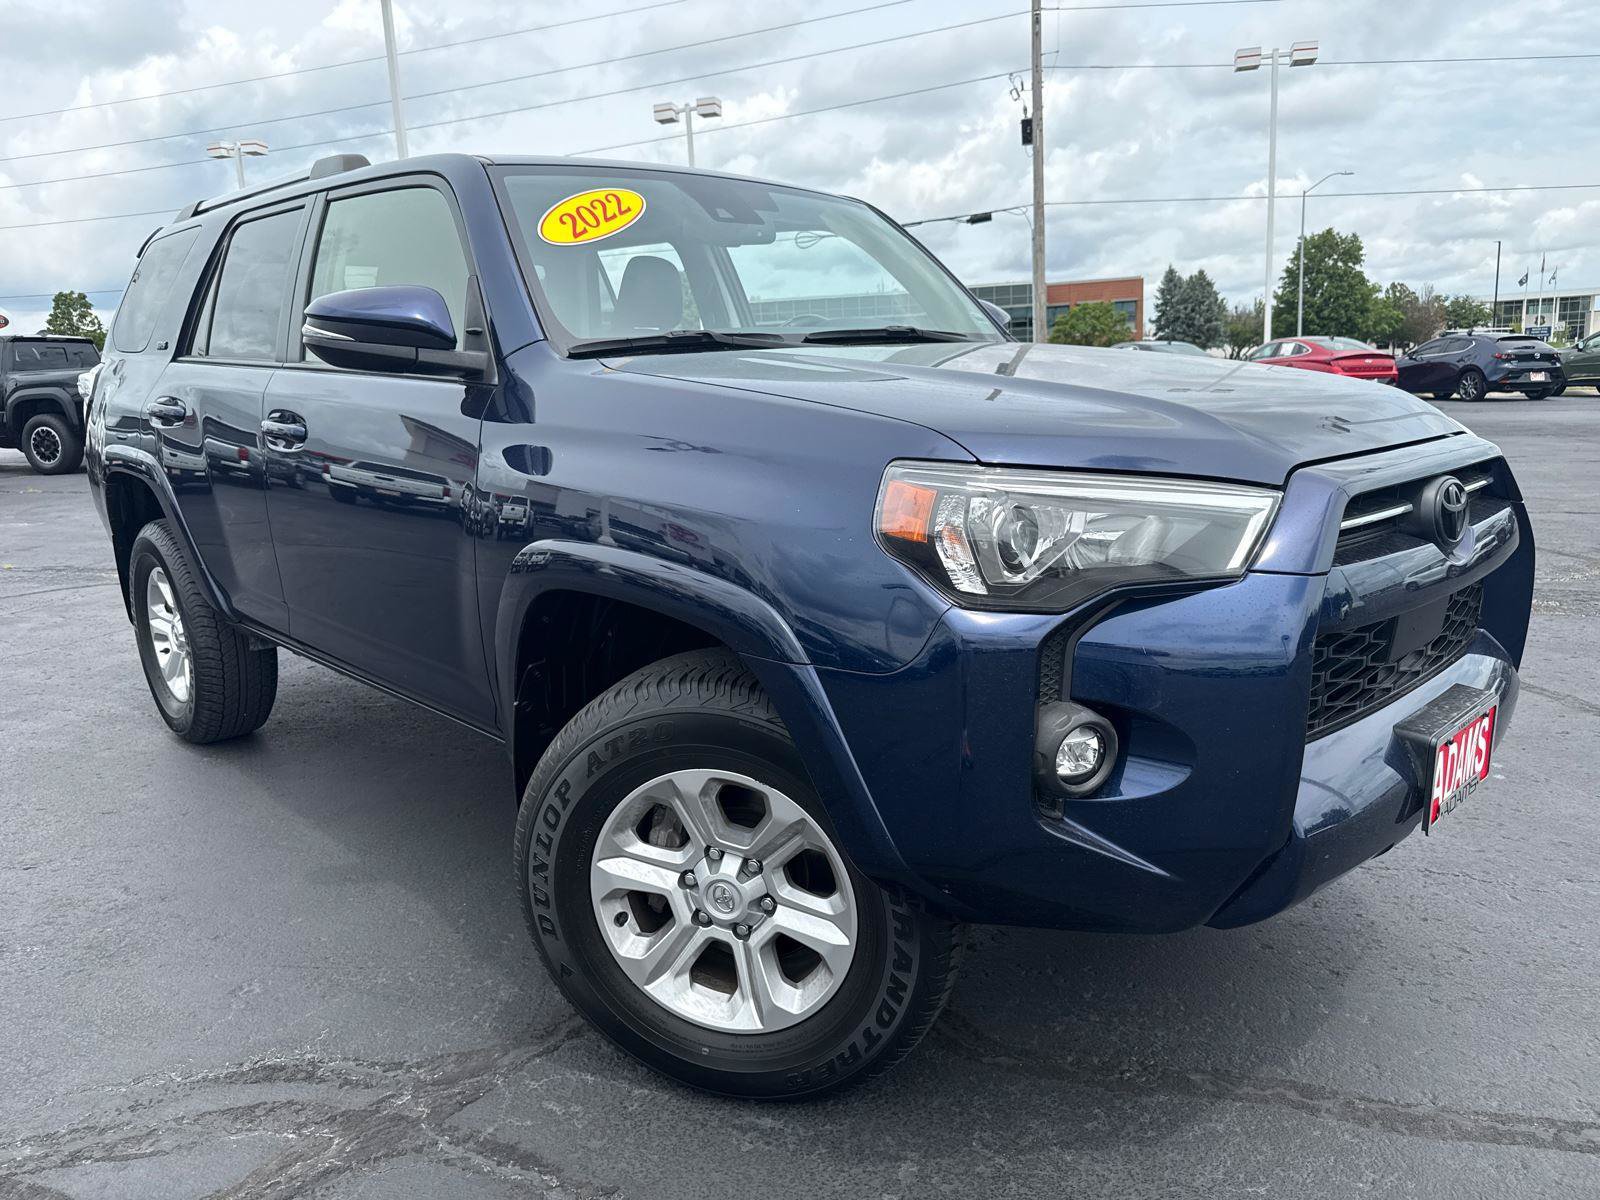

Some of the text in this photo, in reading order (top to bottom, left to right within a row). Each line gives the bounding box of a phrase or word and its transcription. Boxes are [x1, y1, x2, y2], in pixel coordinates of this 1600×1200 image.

[559, 193, 631, 239] 2022
[1433, 716, 1489, 805] ADAMS
[533, 778, 571, 940] DUNLOP
[586, 721, 674, 778] AT20
